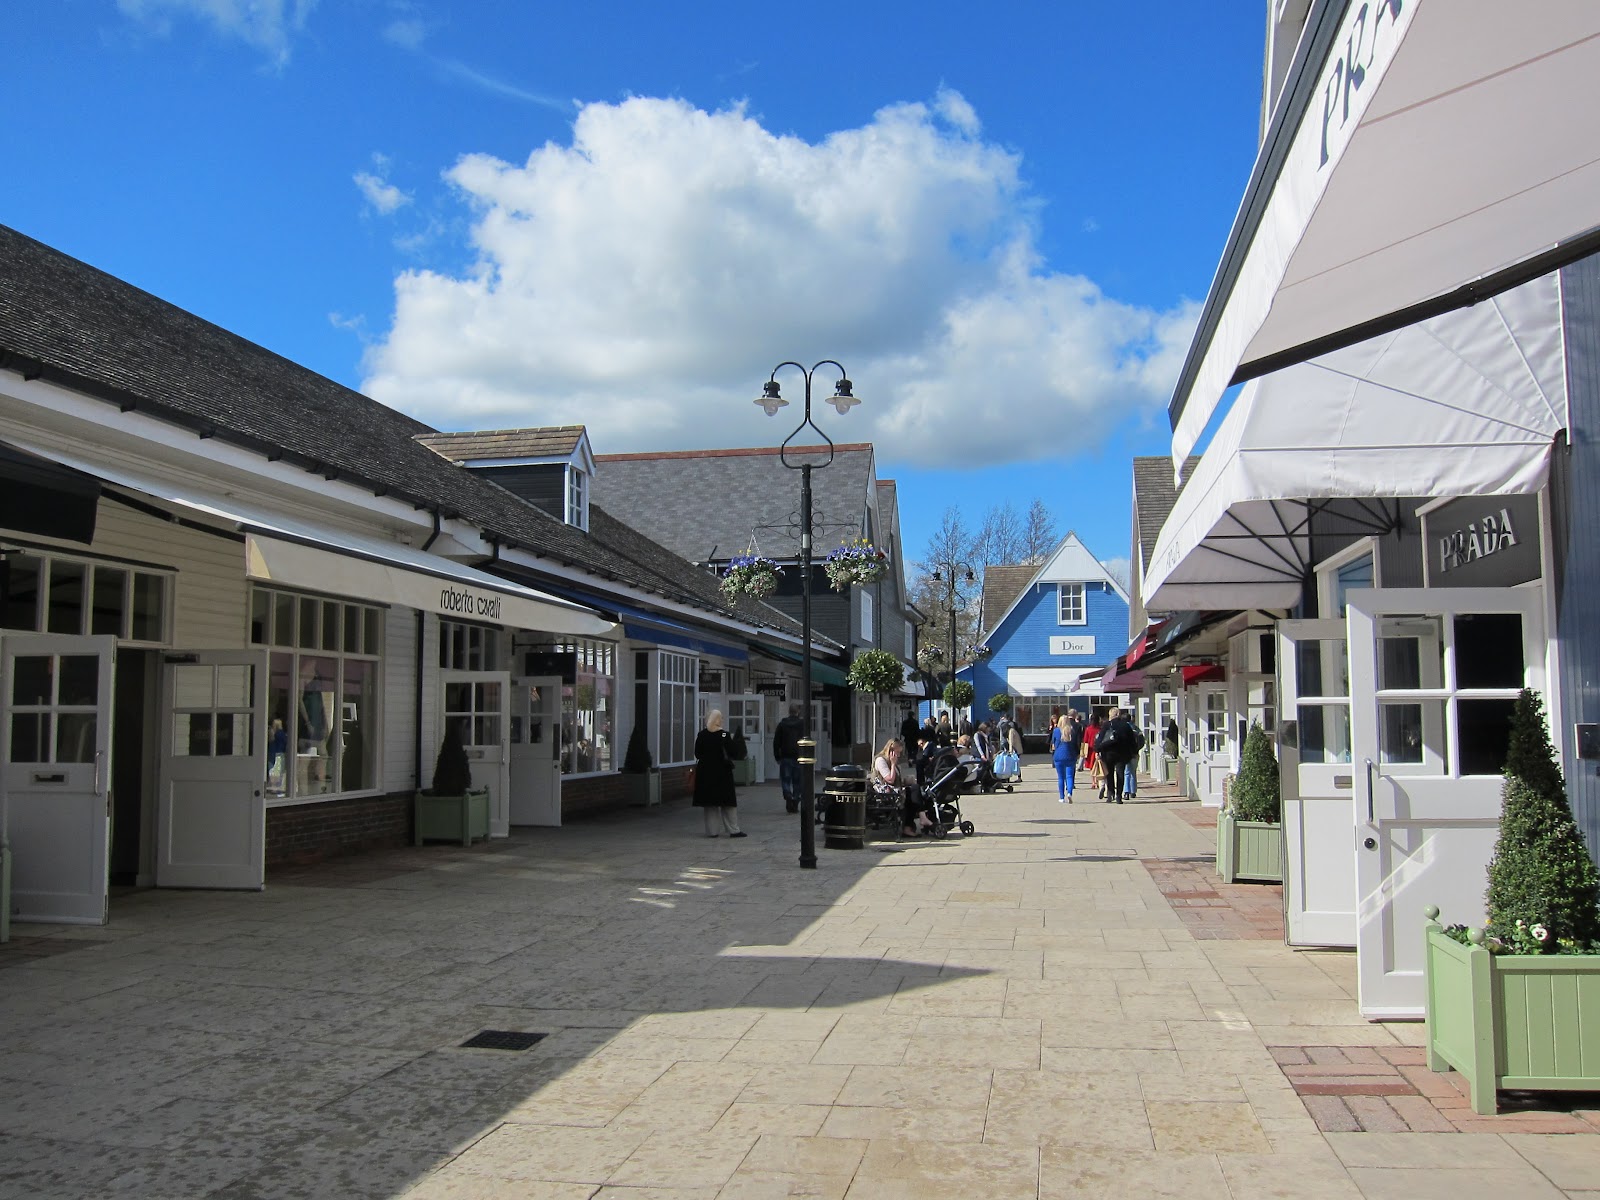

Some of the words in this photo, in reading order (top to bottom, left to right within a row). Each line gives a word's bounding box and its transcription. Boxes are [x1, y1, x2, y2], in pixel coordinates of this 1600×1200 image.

[1440, 508, 1516, 573] PRADA
[440, 586, 474, 614] roberto
[477, 596, 501, 619] cavalli
[1062, 641, 1084, 651] Dior
[758, 689, 785, 697] MUSTO
